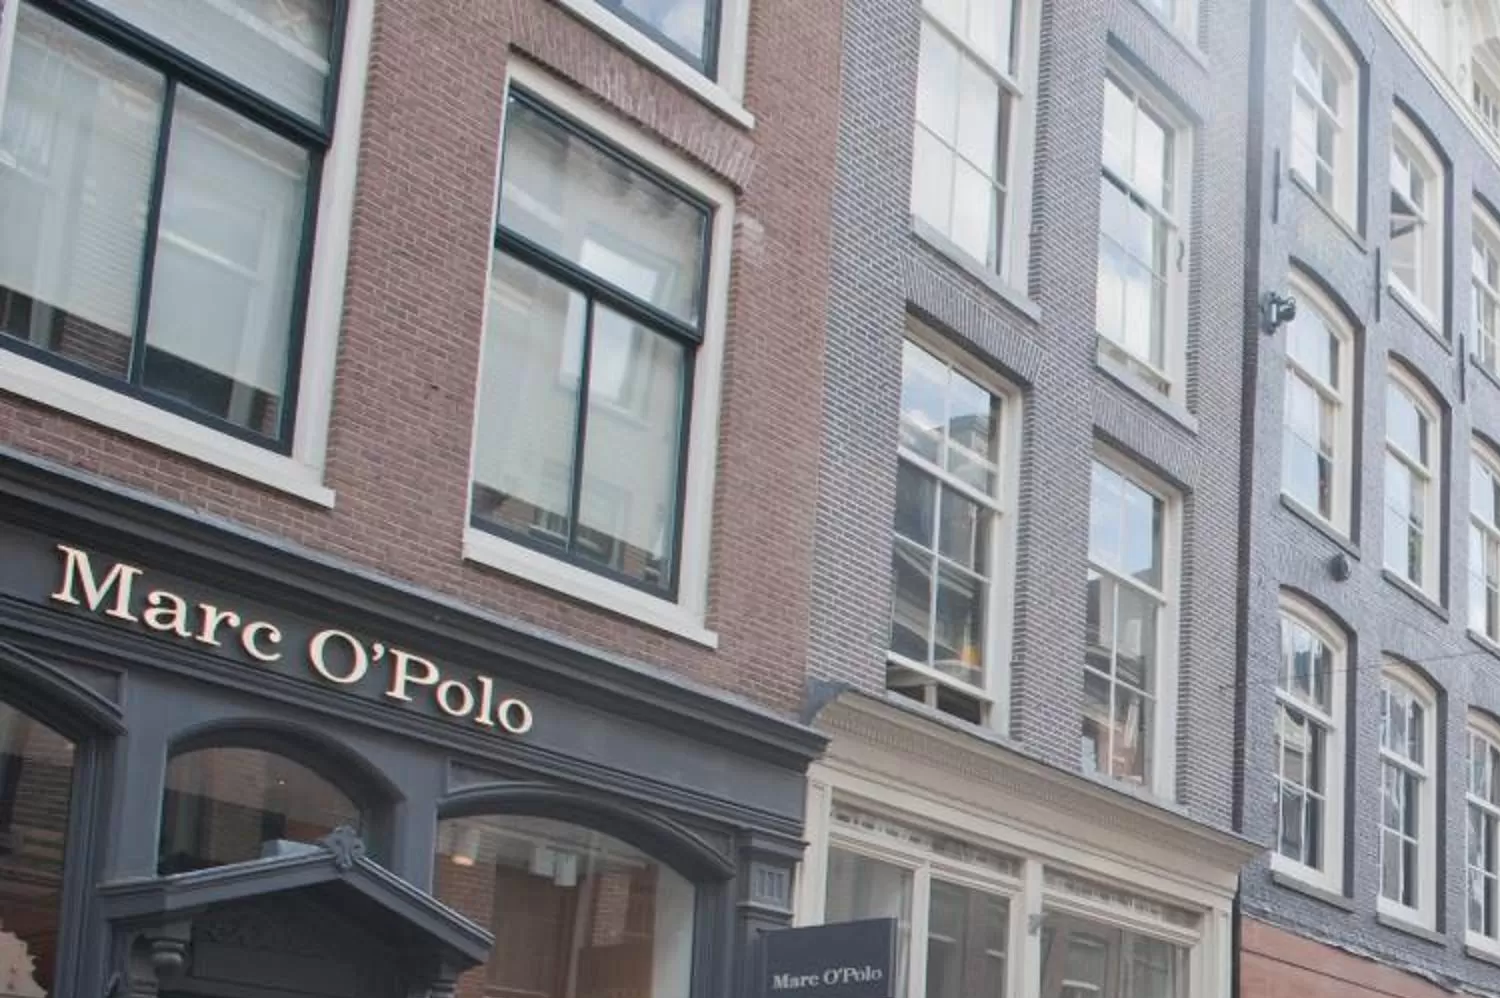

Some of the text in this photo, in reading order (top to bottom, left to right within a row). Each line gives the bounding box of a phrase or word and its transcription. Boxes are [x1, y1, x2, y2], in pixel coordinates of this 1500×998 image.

[49, 543, 534, 736] Marc O'Polo
[773, 965, 883, 989] Marc O'Polo
